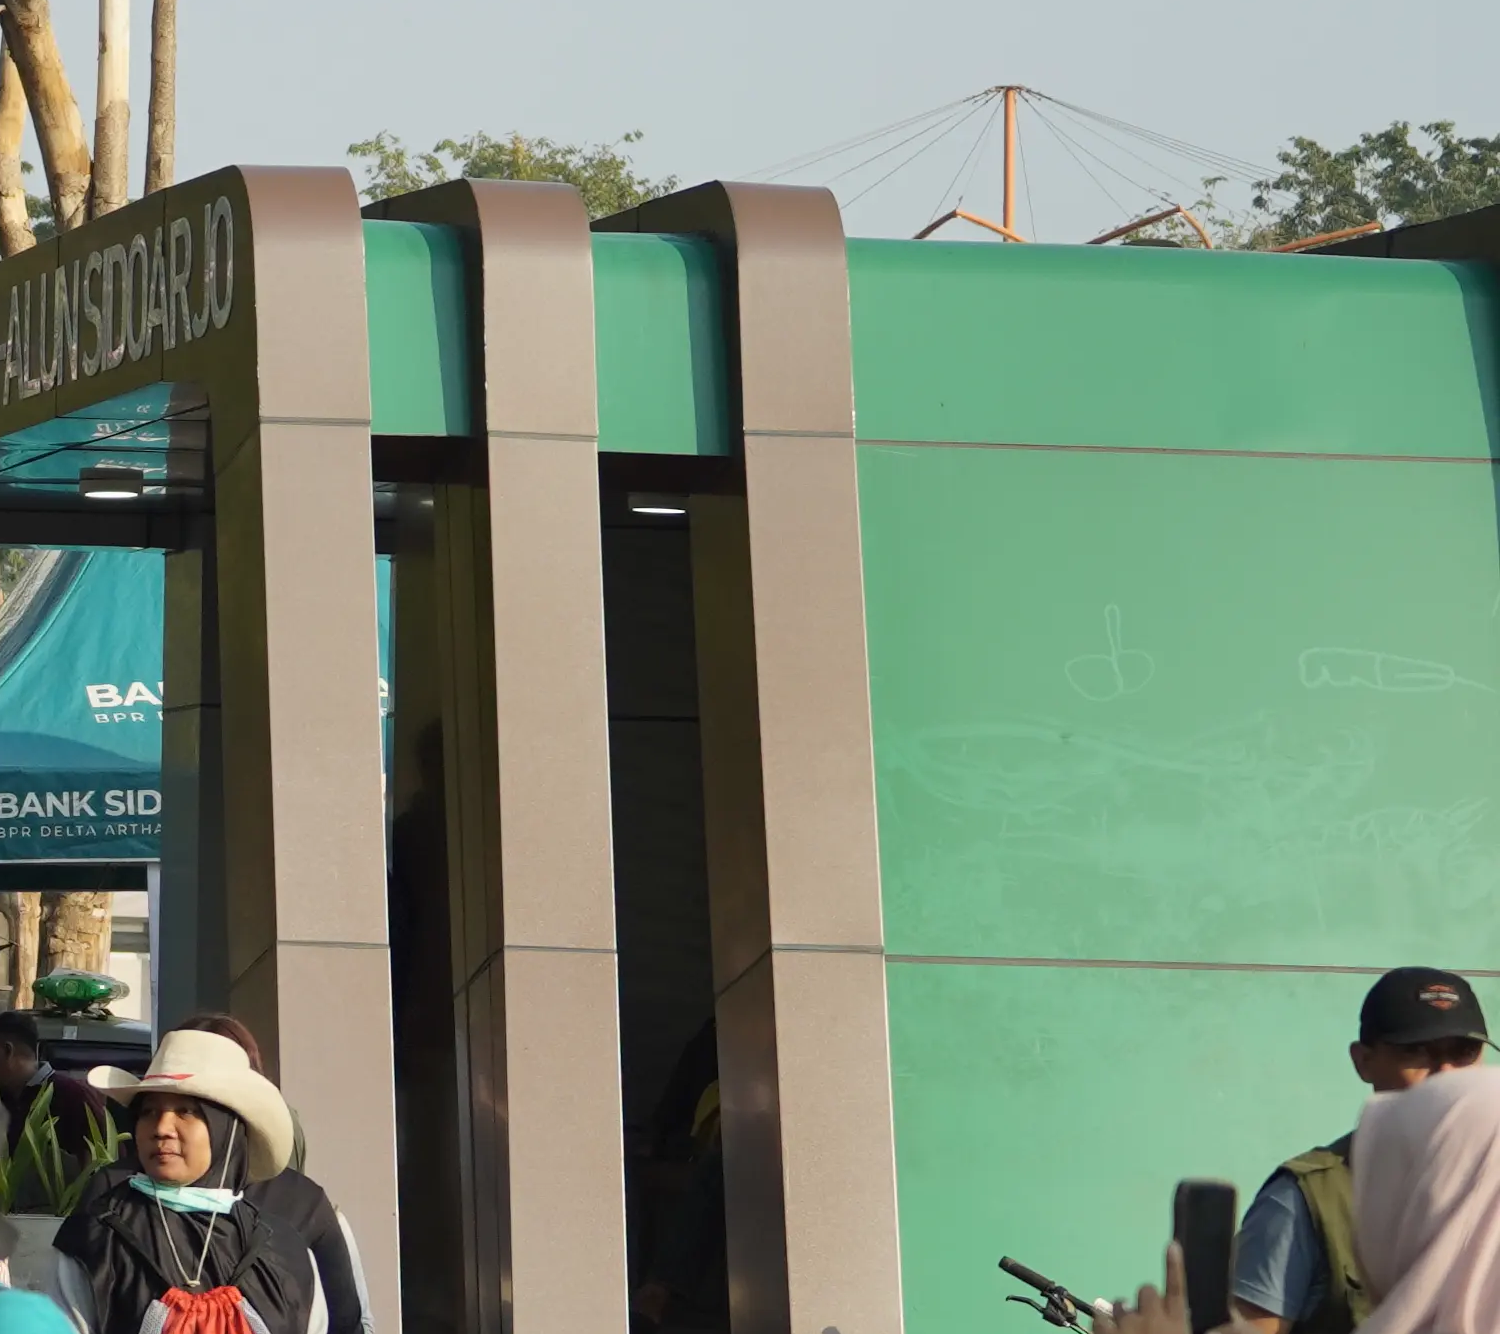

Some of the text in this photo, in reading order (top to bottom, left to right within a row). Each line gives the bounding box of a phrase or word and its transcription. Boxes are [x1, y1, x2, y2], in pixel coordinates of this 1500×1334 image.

[82, 196, 234, 377] SIDOARJO
[94, 712, 146, 724] BPR
[41, 825, 97, 838] DELTA
[104, 823, 162, 836] ARTHA
